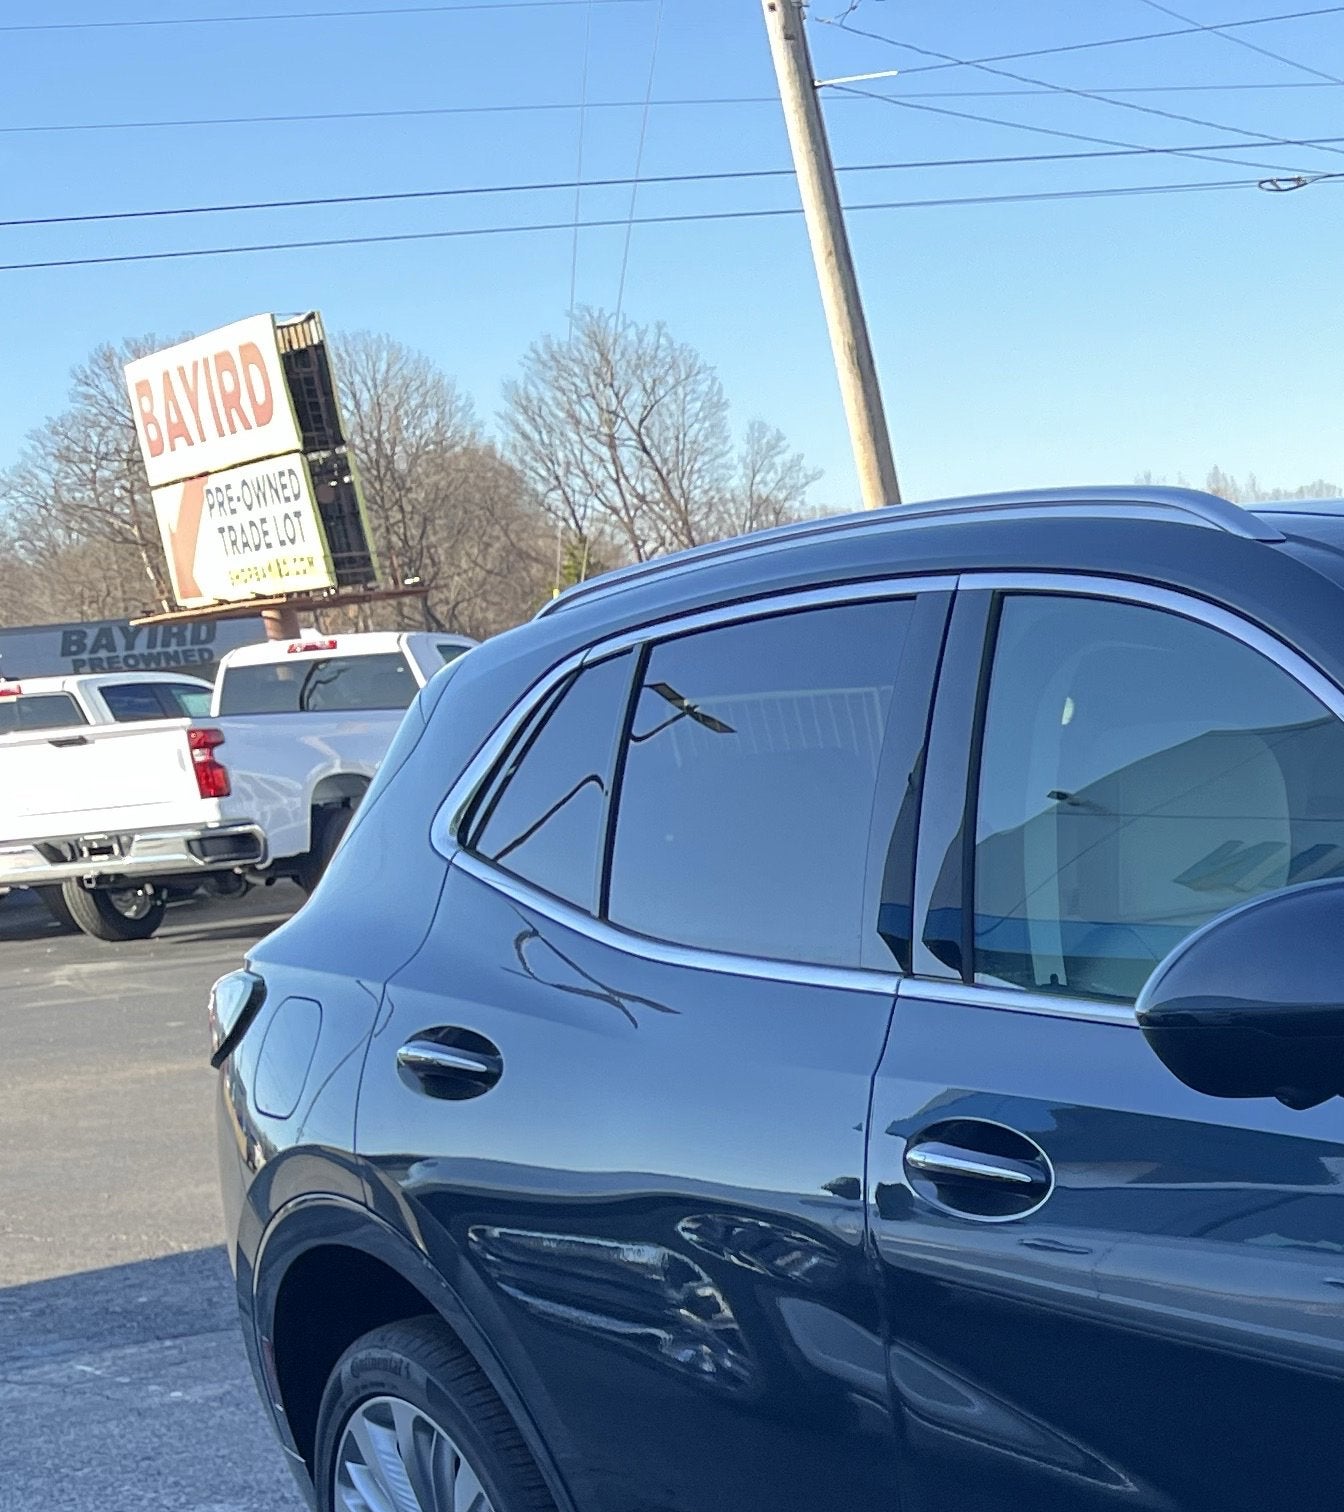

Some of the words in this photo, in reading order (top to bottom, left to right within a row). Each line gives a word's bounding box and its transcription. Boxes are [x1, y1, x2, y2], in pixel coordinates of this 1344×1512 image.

[135, 341, 274, 458] BAYIRD
[205, 468, 301, 518] PRE-OWNED
[217, 517, 272, 557] TRADE
[273, 511, 305, 546] LOT
[60, 621, 217, 657] BAYIRD
[72, 647, 214, 674] PREOWNED
